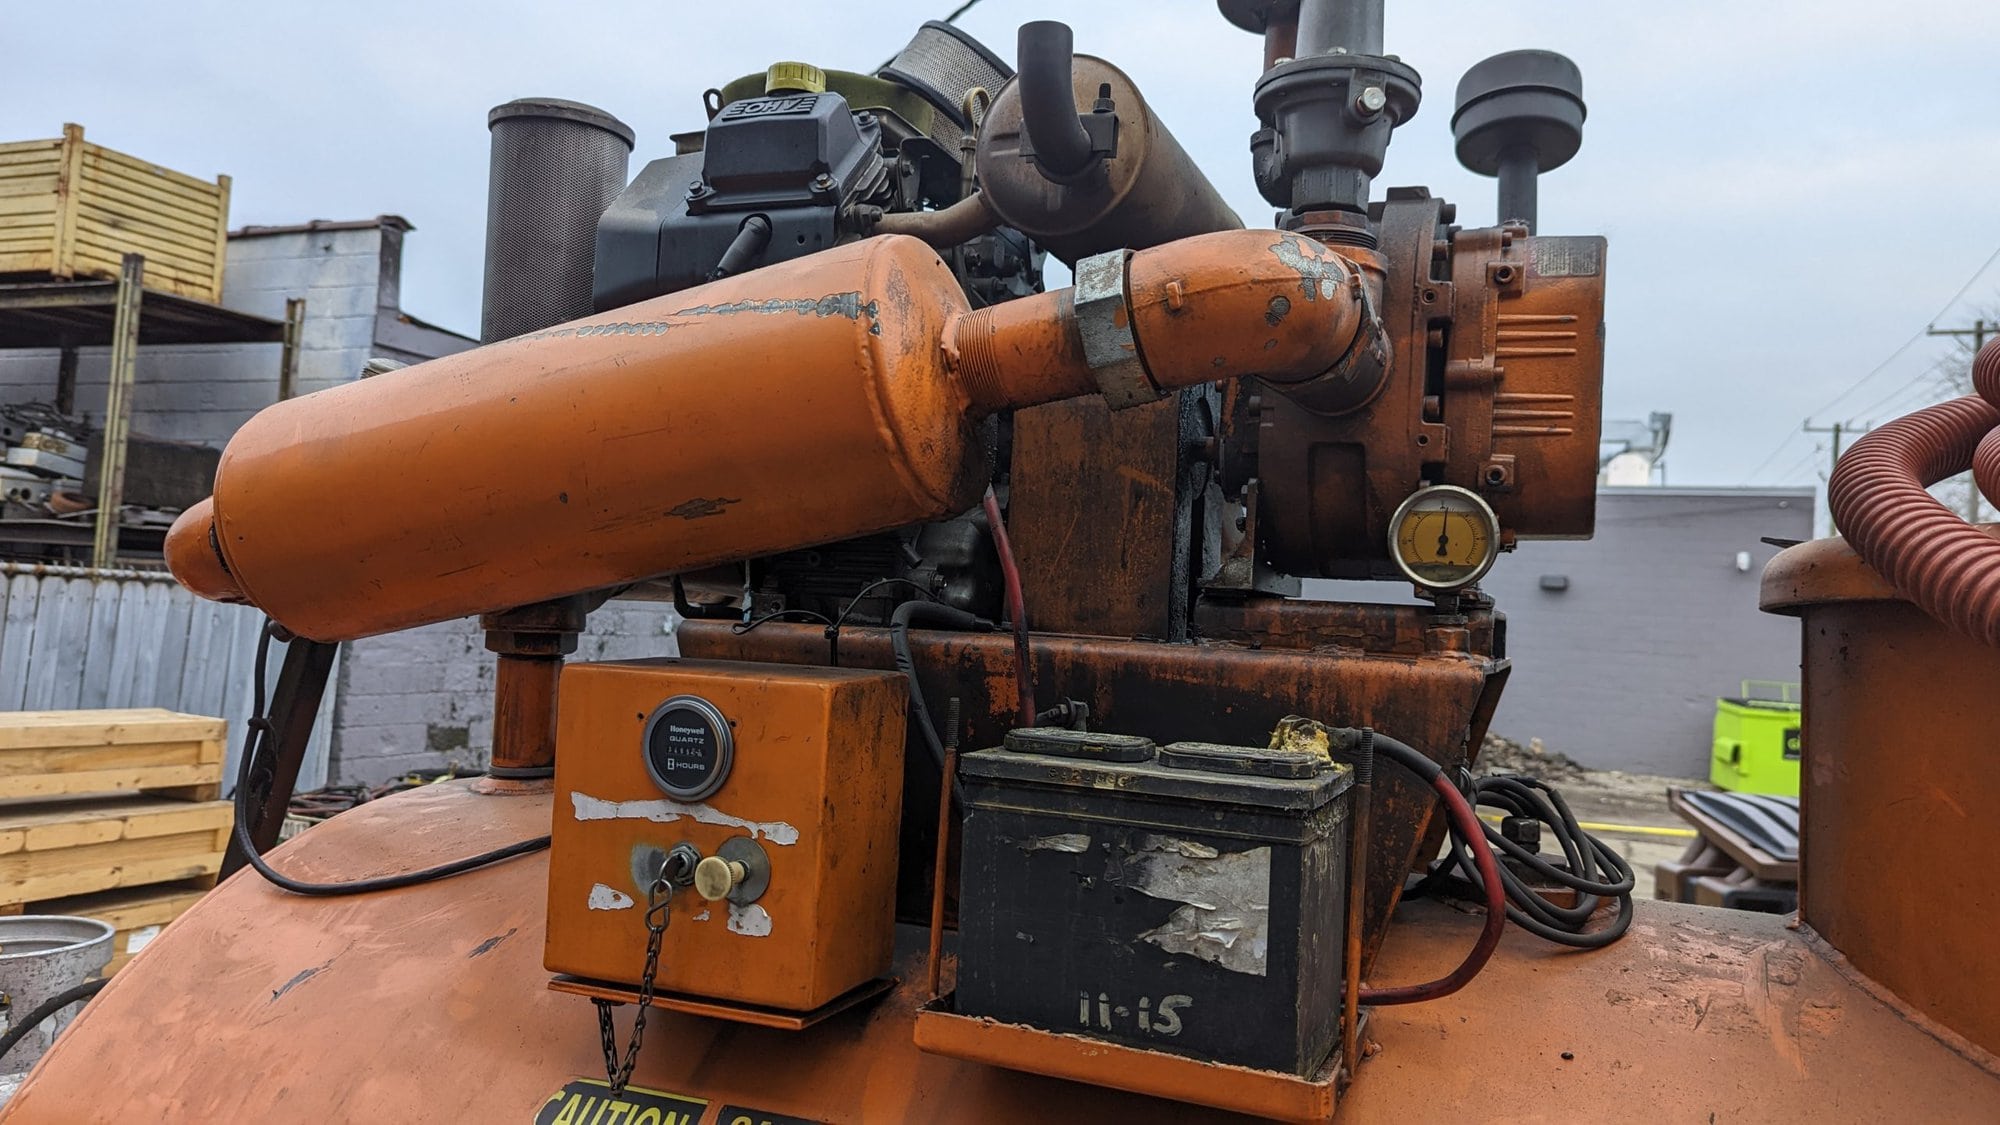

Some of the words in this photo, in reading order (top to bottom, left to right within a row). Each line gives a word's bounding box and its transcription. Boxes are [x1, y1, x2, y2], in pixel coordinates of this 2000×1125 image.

[670, 725, 705, 735] Honeywell
[669, 735, 705, 745] QUARTZ
[676, 762, 706, 771] HOURS
